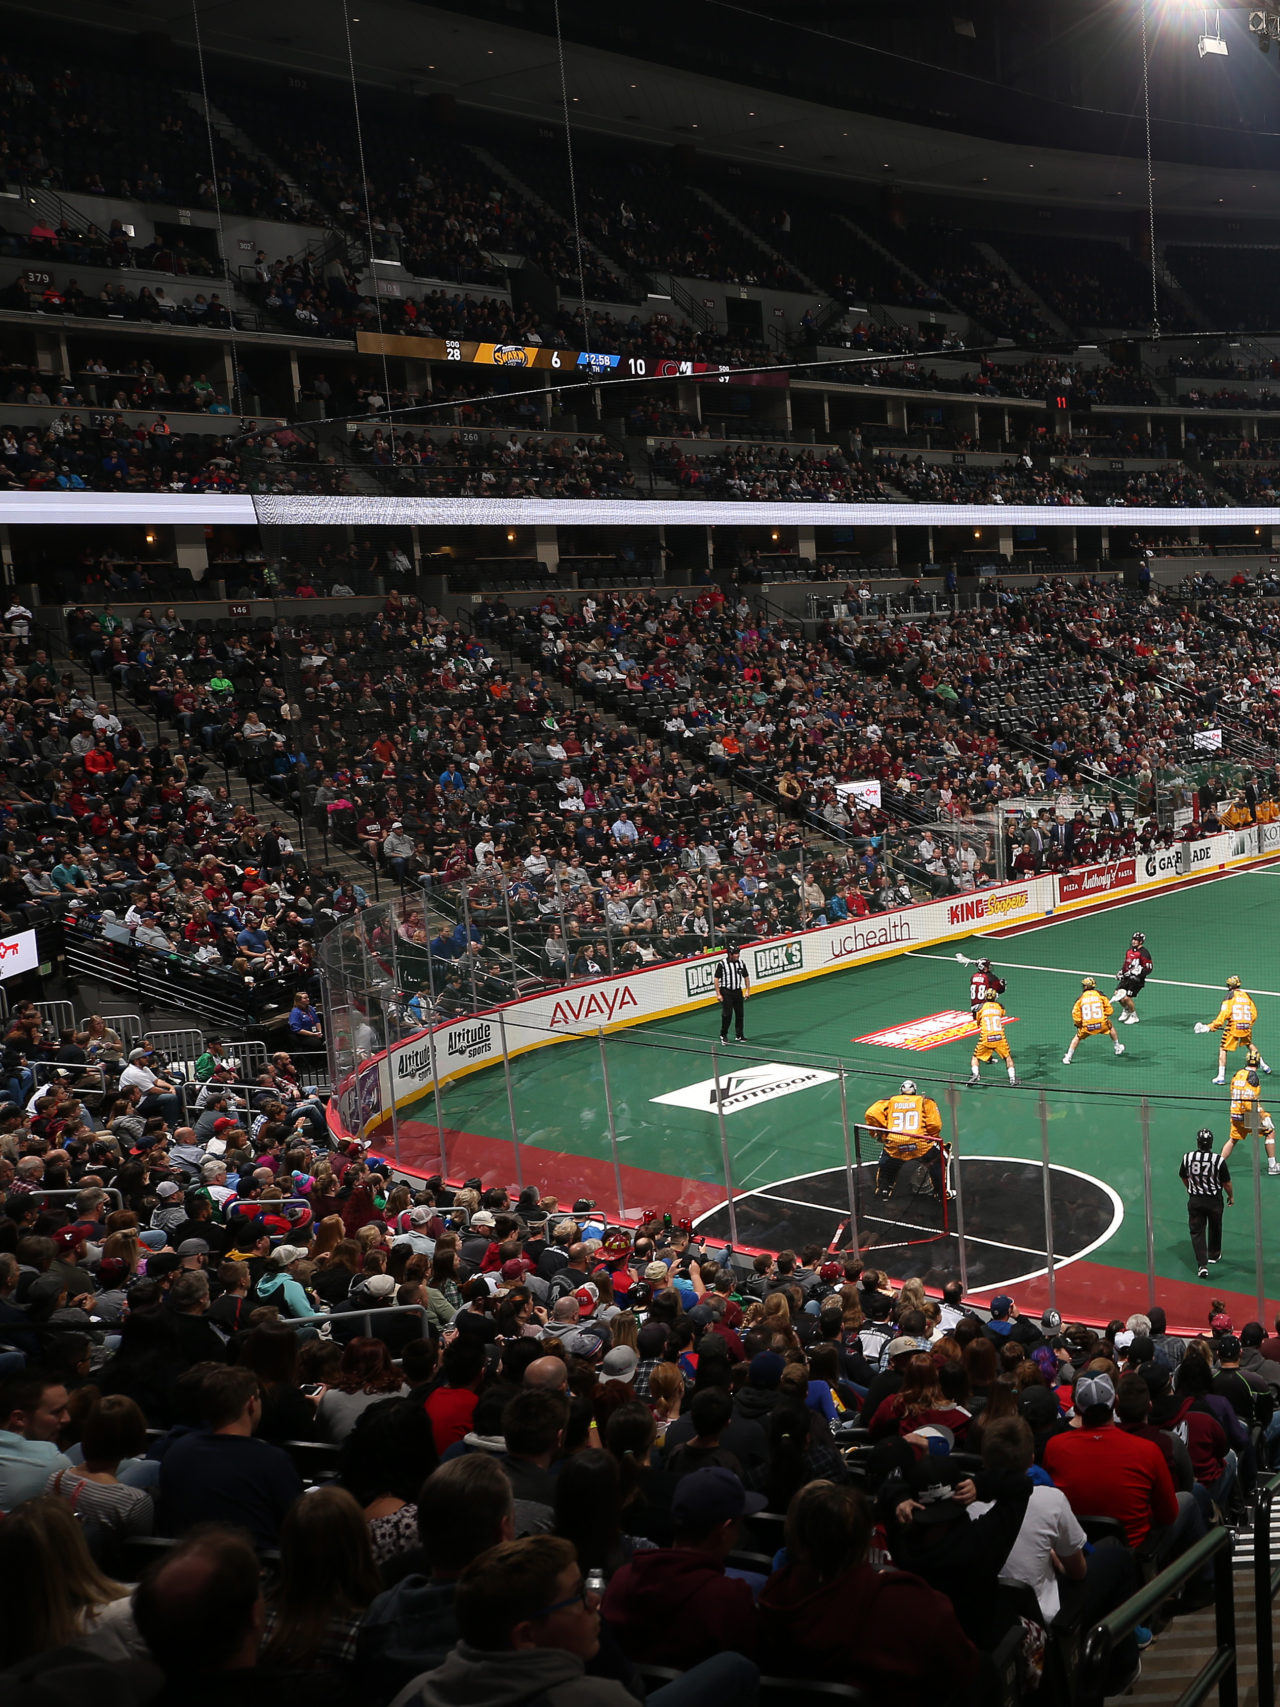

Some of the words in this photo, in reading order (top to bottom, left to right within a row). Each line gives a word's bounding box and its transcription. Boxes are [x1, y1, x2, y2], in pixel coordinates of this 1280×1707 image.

[27, 272, 49, 283] 379
[446, 340, 460, 348] SOG
[447, 349, 462, 361] 28
[494, 351, 526, 365] SWARM
[551, 352, 561, 368] 6
[584, 354, 610, 365] 12:58
[629, 358, 646, 375] 10
[1055, 397, 1065, 408] 11
[462, 433, 478, 441] 260
[231, 606, 246, 614] 146
[1063, 884, 1079, 893] PIZZA
[1081, 868, 1117, 889] Anthony's
[1118, 869, 1133, 878] PASTA
[949, 899, 985, 925] KING
[986, 893, 1027, 916] Soopers
[831, 915, 911, 957] uchealth
[756, 943, 801, 972] DICK'S
[758, 966, 783, 977] SPORTING
[970, 984, 986, 1000] 88
[549, 986, 638, 1028] AVAYA
[1081, 1002, 1103, 1020] 85
[1232, 1004, 1252, 1021] 55
[983, 1015, 1002, 1031] 10
[447, 1022, 491, 1052] Altitude
[468, 1042, 491, 1058] sports
[721, 1073, 818, 1108] OUTDOOR
[891, 1111, 919, 1132] 30
[1191, 1161, 1211, 1176] 87
